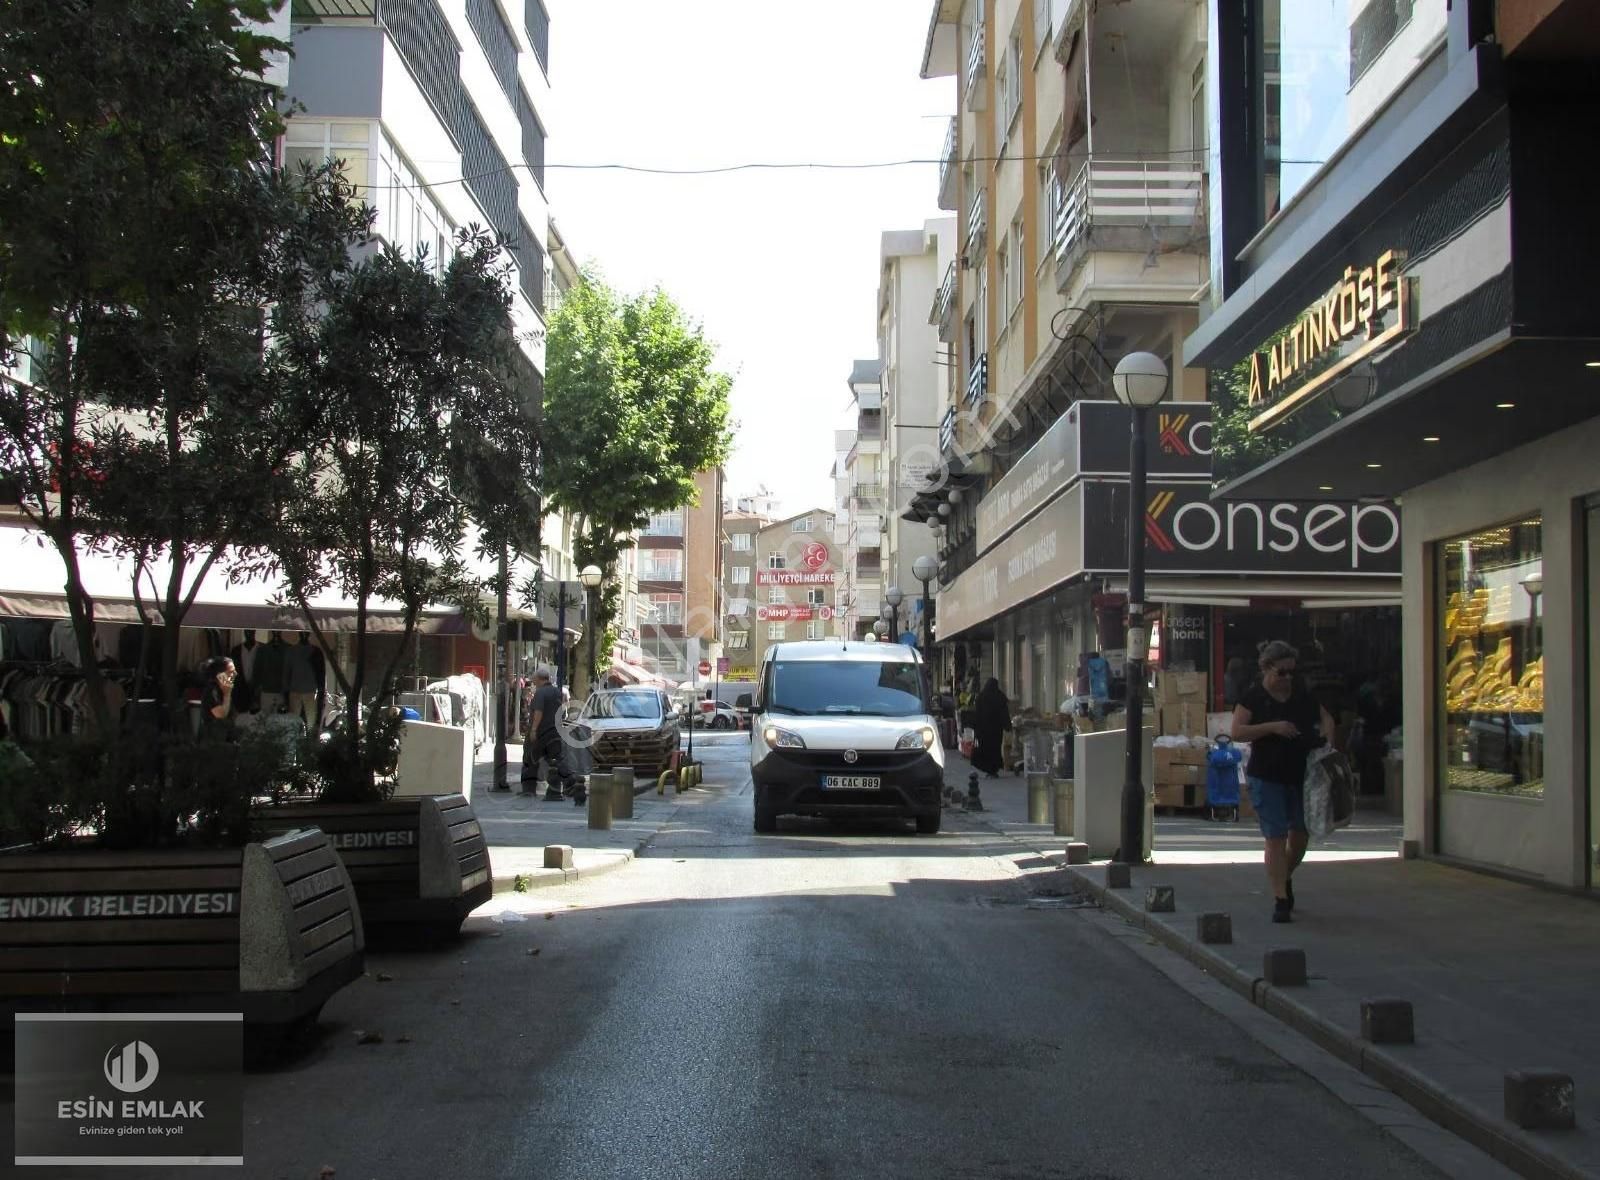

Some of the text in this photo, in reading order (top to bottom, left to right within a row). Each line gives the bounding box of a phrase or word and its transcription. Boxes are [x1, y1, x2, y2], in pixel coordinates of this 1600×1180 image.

[1268, 249, 1394, 391] ALTINKÖŞE
[760, 572, 802, 585] MİLLİYETÇİ
[768, 609, 788, 617] MHP
[827, 777, 838, 787] 06
[842, 778, 858, 787] CAC
